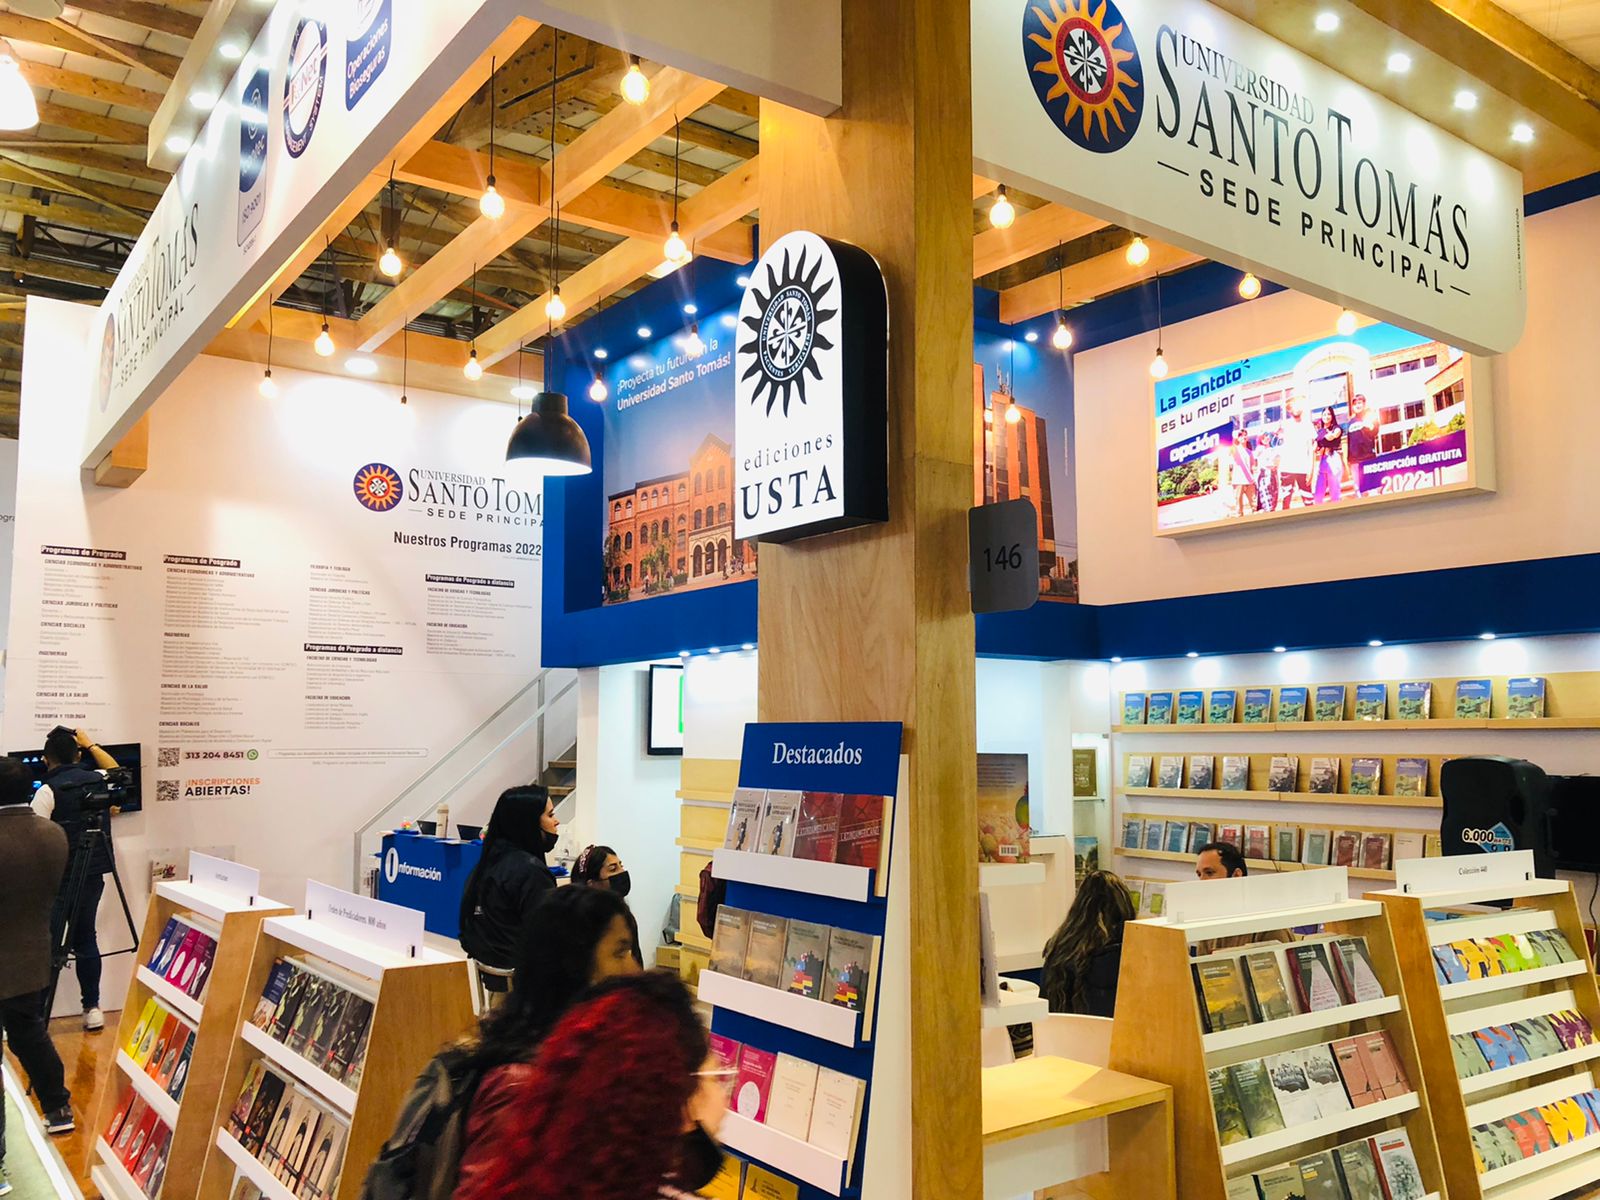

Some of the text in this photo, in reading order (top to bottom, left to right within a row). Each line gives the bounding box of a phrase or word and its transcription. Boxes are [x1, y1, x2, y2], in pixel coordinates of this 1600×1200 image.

[347, 18, 388, 79] Operaciones
[349, 45, 385, 99] Bioseguras
[1181, 34, 1315, 125] UNIVERSIDAD
[1155, 24, 1322, 200] SANTO
[1327, 107, 1470, 270] TOMÁS
[1199, 168, 1281, 226] SEDE
[1301, 211, 1443, 294] PRINCIPAL
[115, 276, 150, 368] SANTO
[140, 292, 185, 351] PRINCIPAL
[617, 369, 654, 395] ¡Proyecta
[655, 365, 665, 375] tu
[709, 338, 718, 352] la
[617, 352, 731, 411] Universidad Santo Tomás!
[1160, 367, 1242, 414] La Santoto
[1160, 394, 1234, 433] es tu mejor
[744, 433, 833, 472] ediciones
[1169, 433, 1220, 463] opción
[1363, 448, 1463, 475] INSCRIPCIÓN GRATUITA
[408, 468, 489, 509] SANTO
[419, 469, 486, 486] UNIVERSIDAD
[740, 464, 837, 520] USTA
[427, 507, 467, 520] SEDE
[41, 545, 123, 560] Programas de Pregrado
[164, 554, 198, 564] Programas
[208, 558, 238, 567] Posgrado
[394, 531, 542, 556] Nuestros Programas 2022
[983, 543, 1022, 572] 146
[185, 751, 244, 760] 313 204 8451
[772, 741, 863, 765] Destacados
[185, 778, 261, 787] ¡INSCRIPCIONES
[185, 785, 251, 797] ABIERTAS!
[1463, 829, 1494, 843] 6.000
